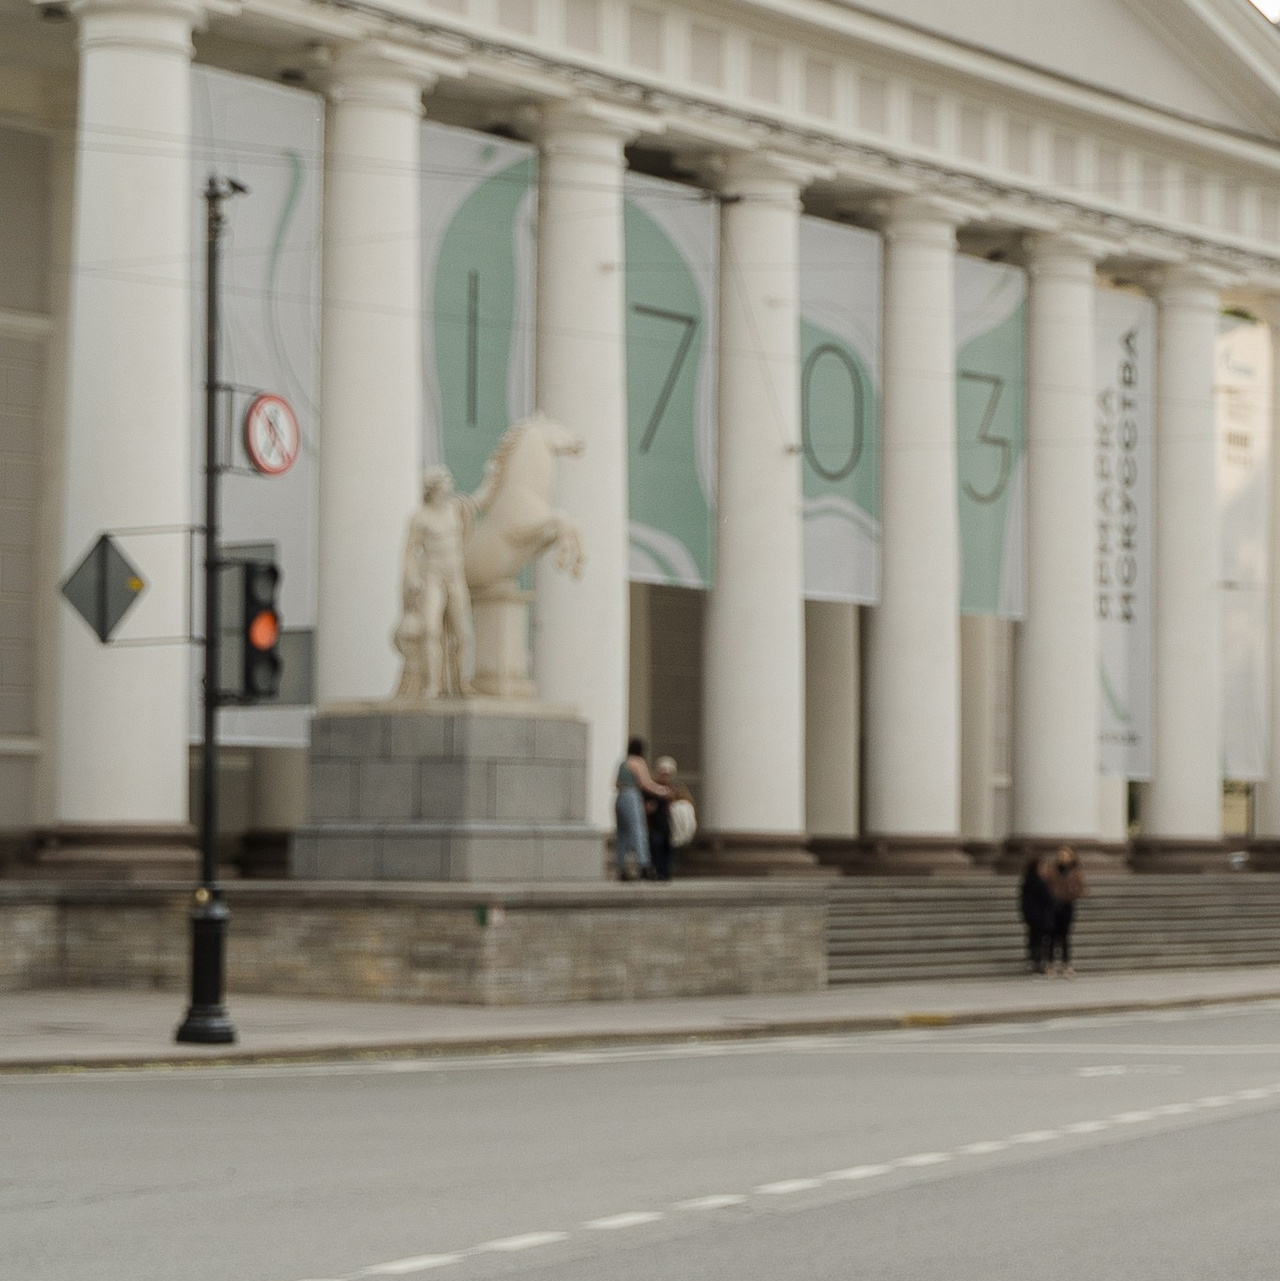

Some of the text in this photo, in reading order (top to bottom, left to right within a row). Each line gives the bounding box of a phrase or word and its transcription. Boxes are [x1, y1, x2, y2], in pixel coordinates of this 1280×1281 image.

[466, 270, 1012, 505] 1 7 0 3
[1095, 387, 1115, 620] ЯРМАРКА
[1116, 328, 1138, 624] ИСКУССТВА
